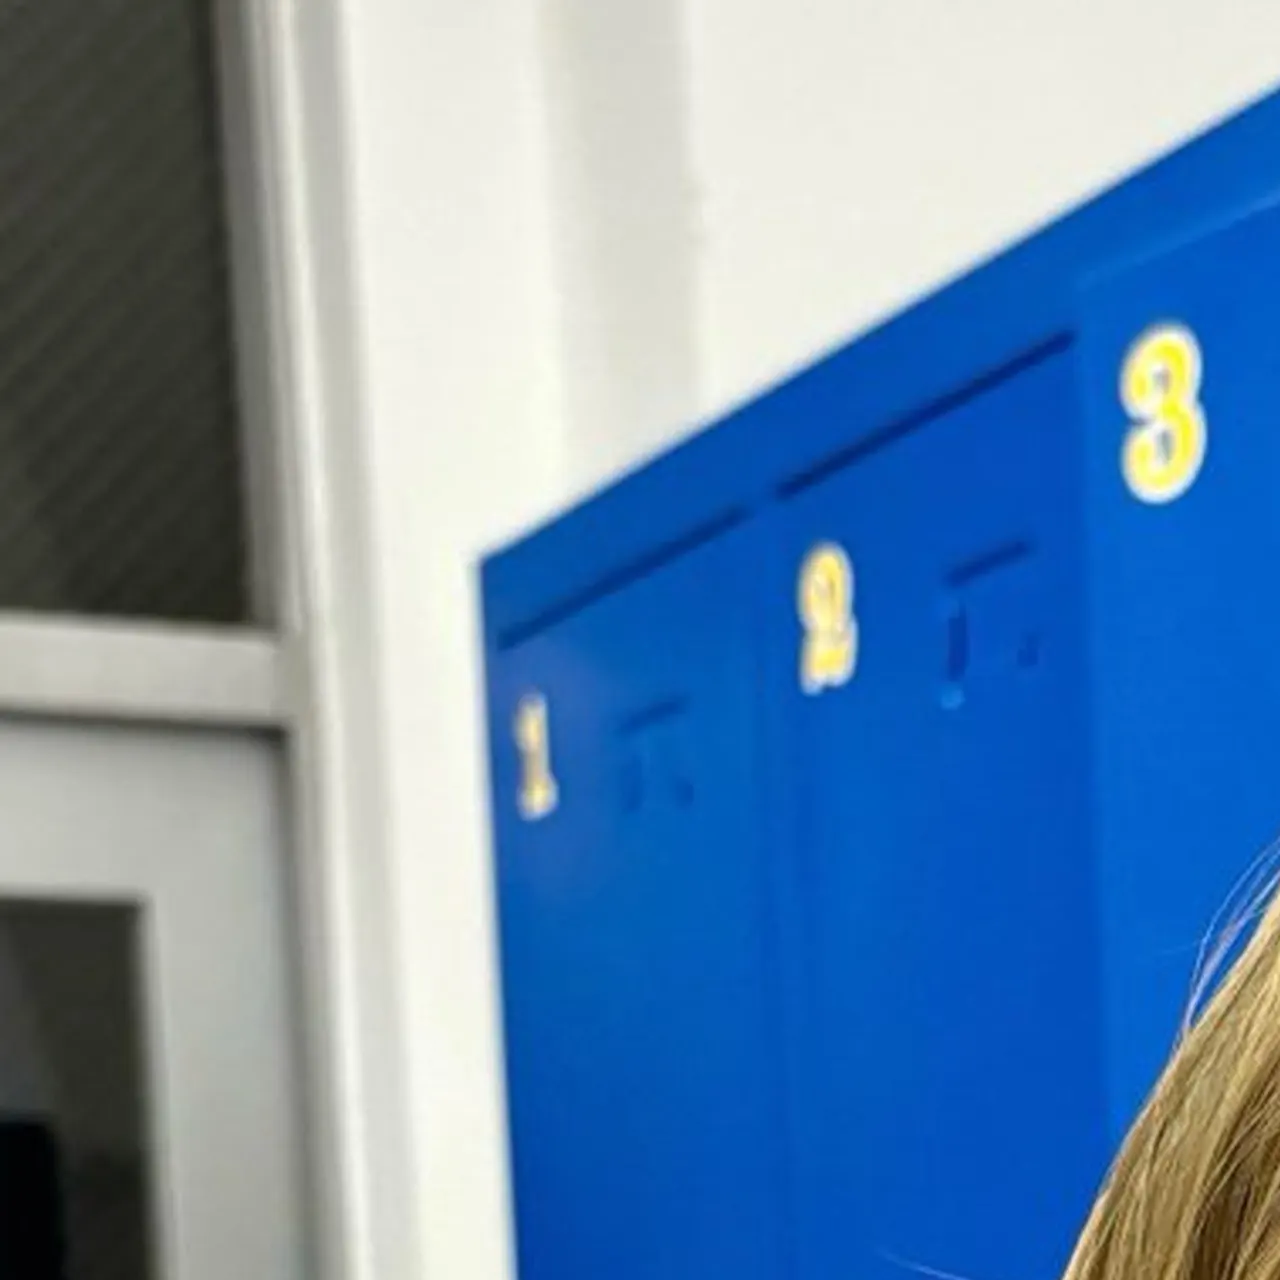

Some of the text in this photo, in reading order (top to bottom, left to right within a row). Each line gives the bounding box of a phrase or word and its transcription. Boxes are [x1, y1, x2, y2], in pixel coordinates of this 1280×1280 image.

[1118, 322, 1207, 504] 3
[797, 541, 858, 694] 2
[514, 692, 559, 820] 1
